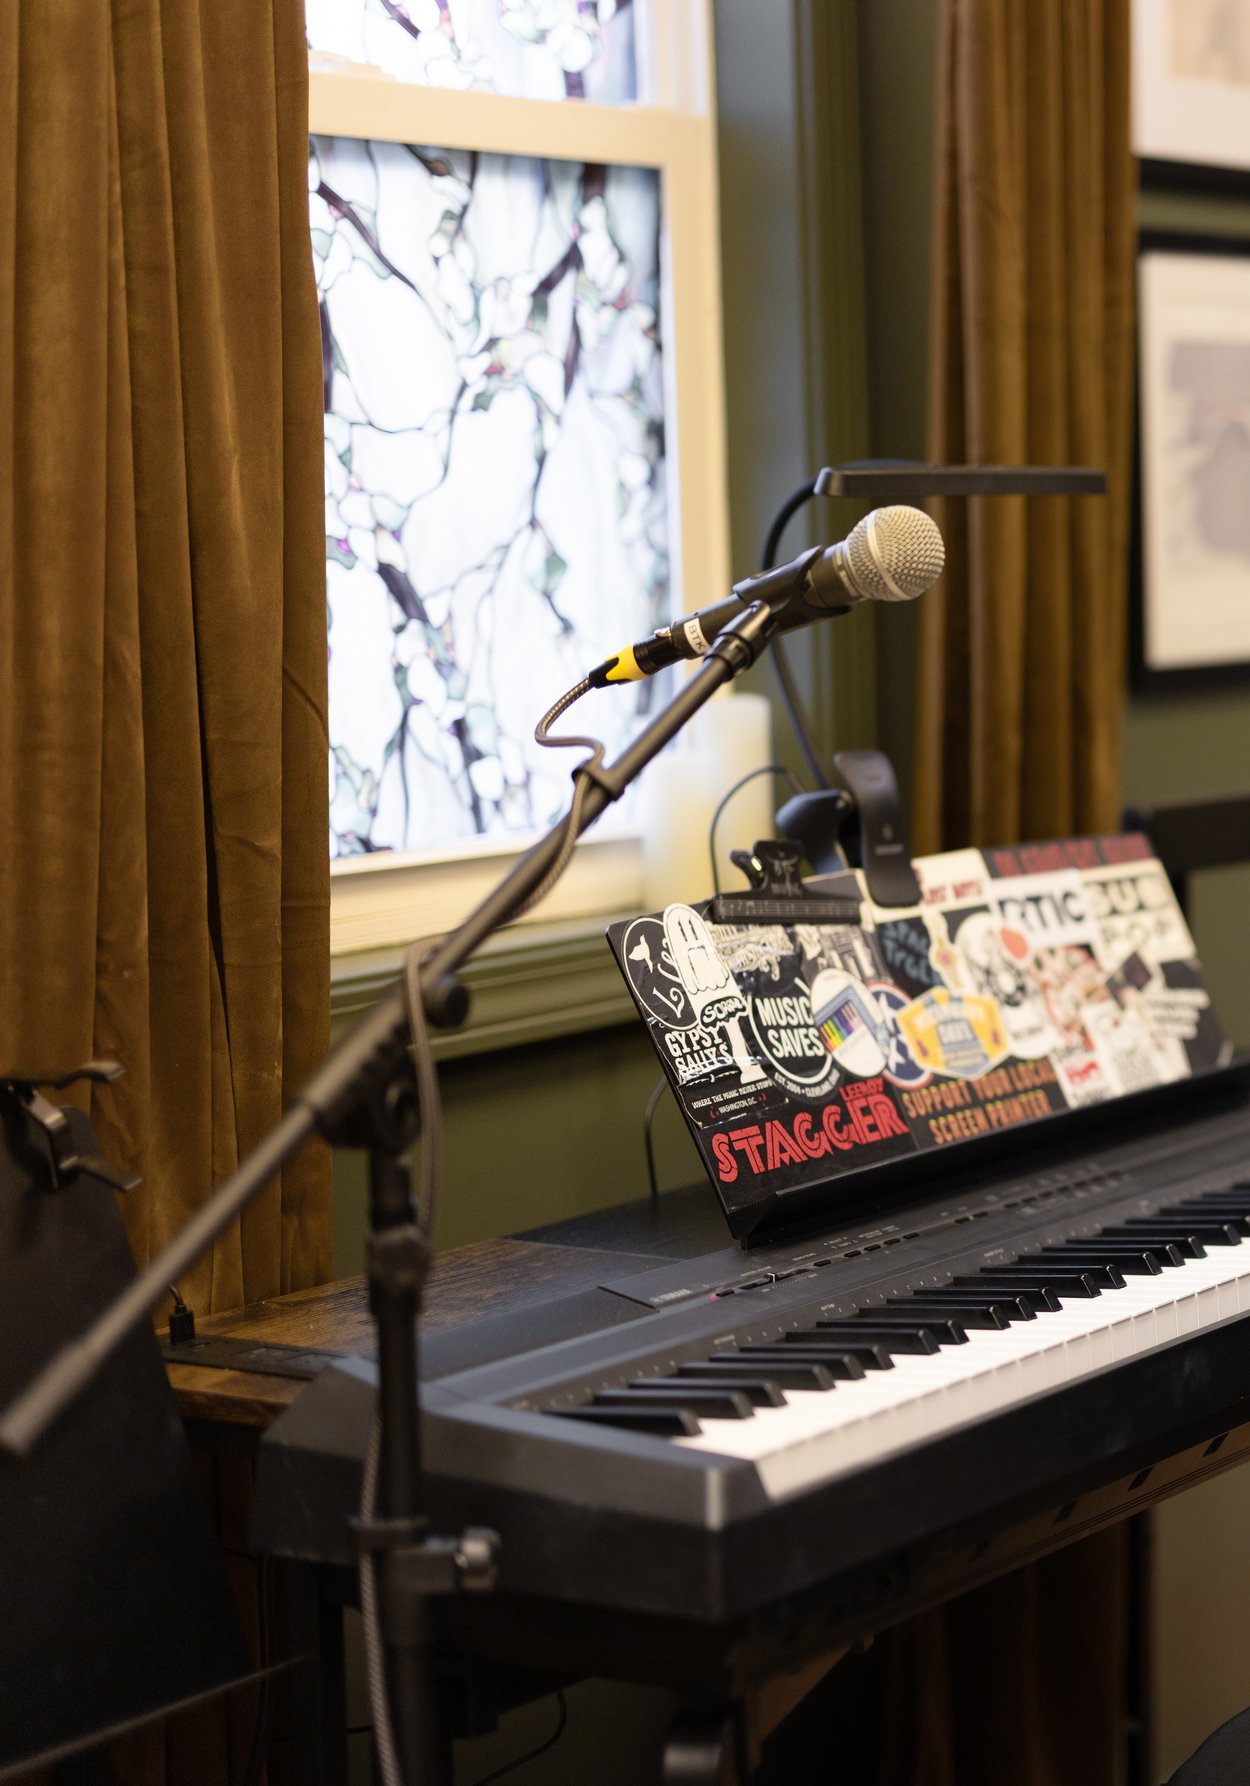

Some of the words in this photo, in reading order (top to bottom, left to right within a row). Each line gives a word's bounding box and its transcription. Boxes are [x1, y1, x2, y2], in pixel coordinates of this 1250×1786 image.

[689, 624, 706, 650] BTK
[754, 995, 815, 1026] MUSIC
[664, 1024, 723, 1057] GYPSY
[767, 1026, 825, 1058] SAVES
[691, 1099, 712, 1109] WHERE
[711, 1094, 723, 1103] THE
[902, 1078, 972, 1119] SUPPORT
[712, 1093, 910, 1183] STAGGER
[929, 1104, 990, 1145] SCREEN
